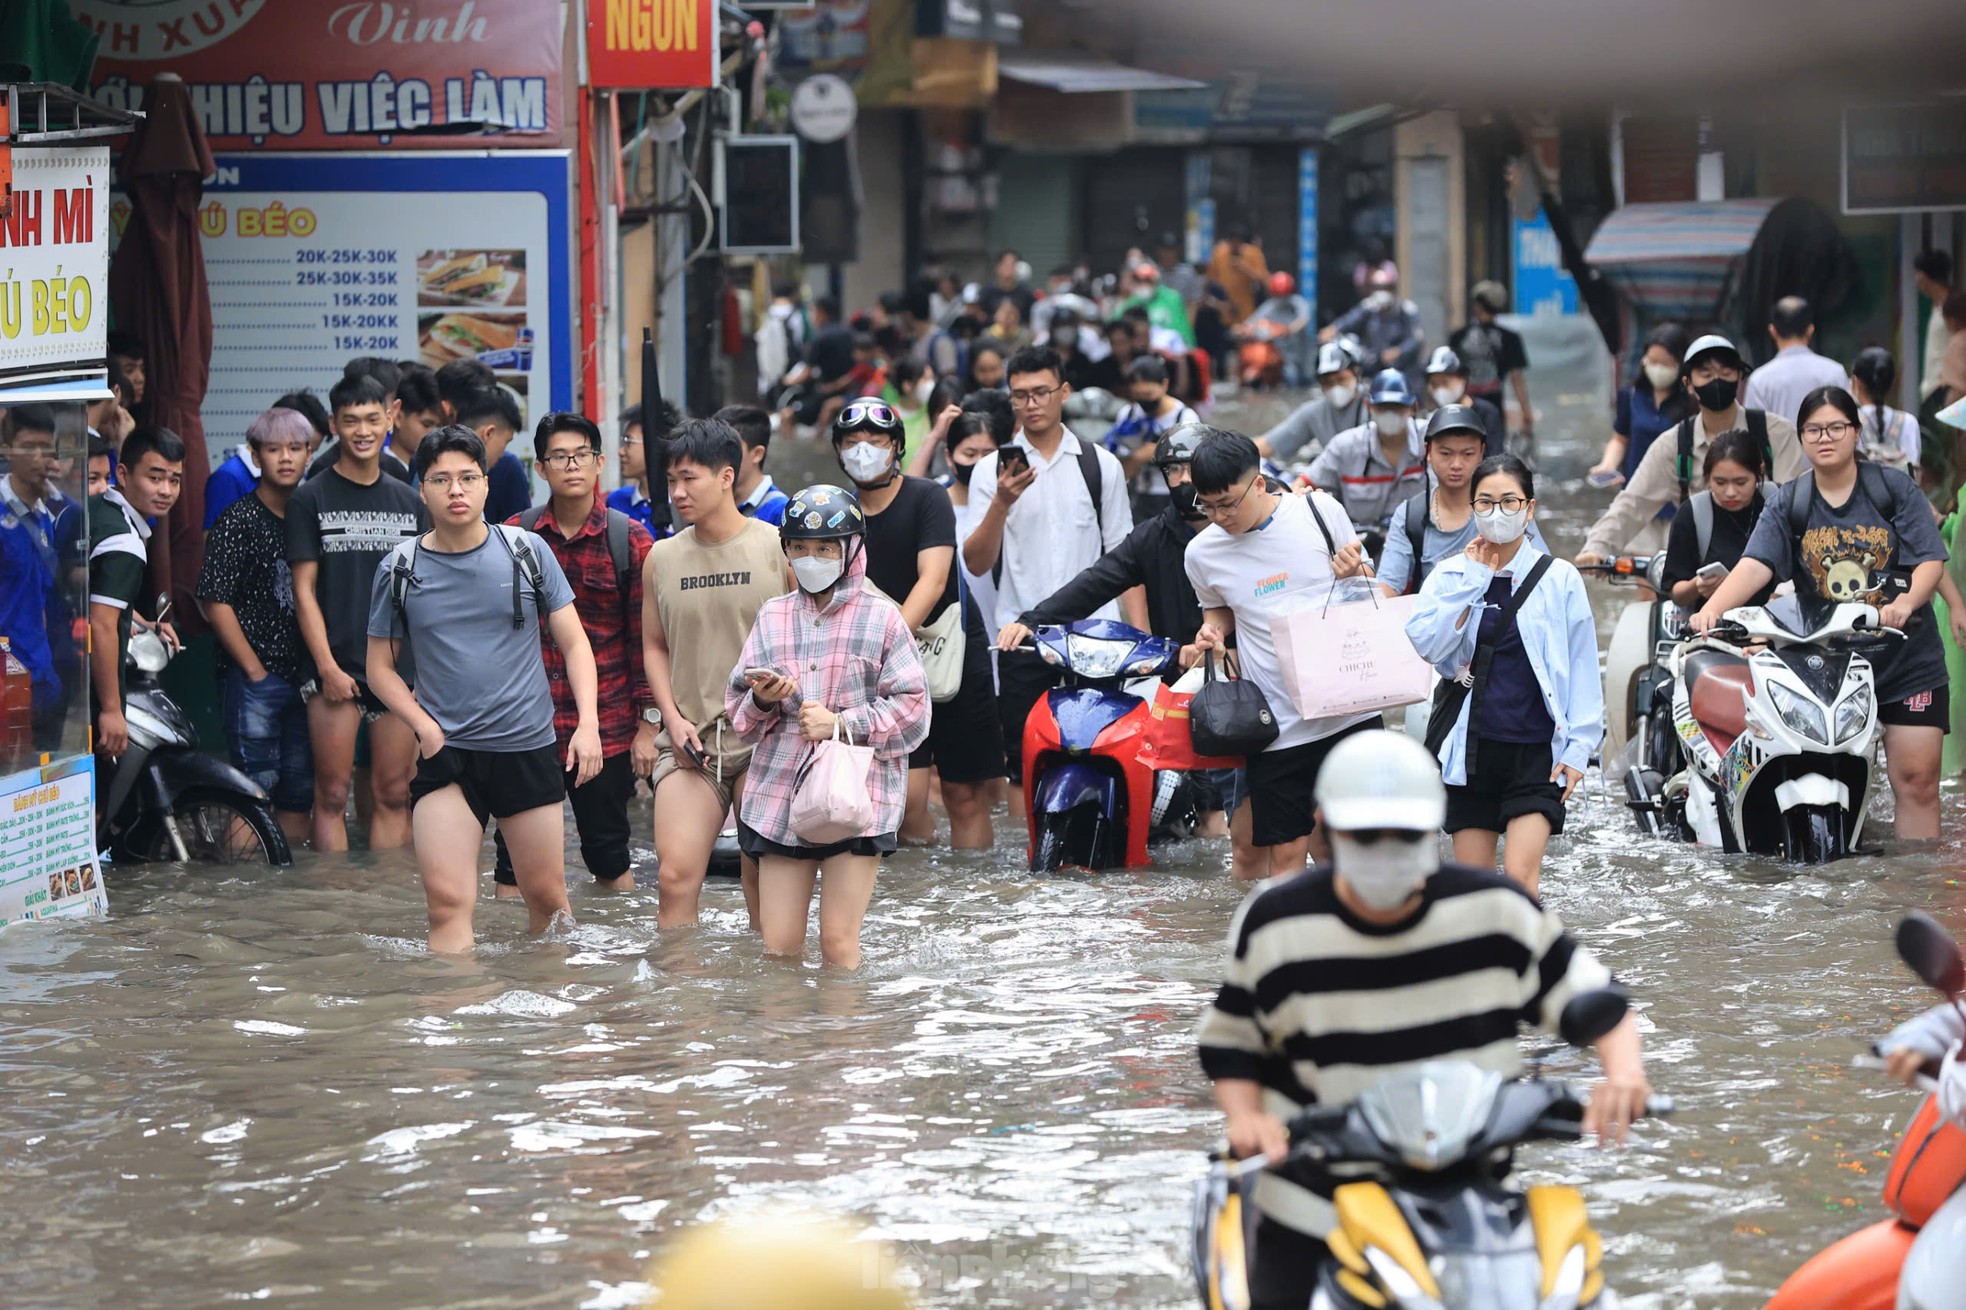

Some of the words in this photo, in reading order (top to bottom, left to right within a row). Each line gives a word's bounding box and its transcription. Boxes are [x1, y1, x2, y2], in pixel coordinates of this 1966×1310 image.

[327, 0, 494, 46] Vinh
[187, 74, 304, 145] HIỆU
[317, 70, 432, 144] VIỆC
[445, 69, 547, 131] LÀM
[53, 174, 94, 245] MÌ
[237, 201, 317, 238] BÉO
[296, 249, 398, 264] 20K-25K-30K
[296, 271, 398, 286] 25K-30K-35K
[31, 264, 92, 337] BÉO
[333, 293, 398, 307] 15K-20K
[322, 314, 399, 329] 15K-20KK
[334, 336, 399, 350] 15K-20K
[680, 571, 751, 591] BROOKLYN
[1254, 579, 1286, 598] FLOWER
